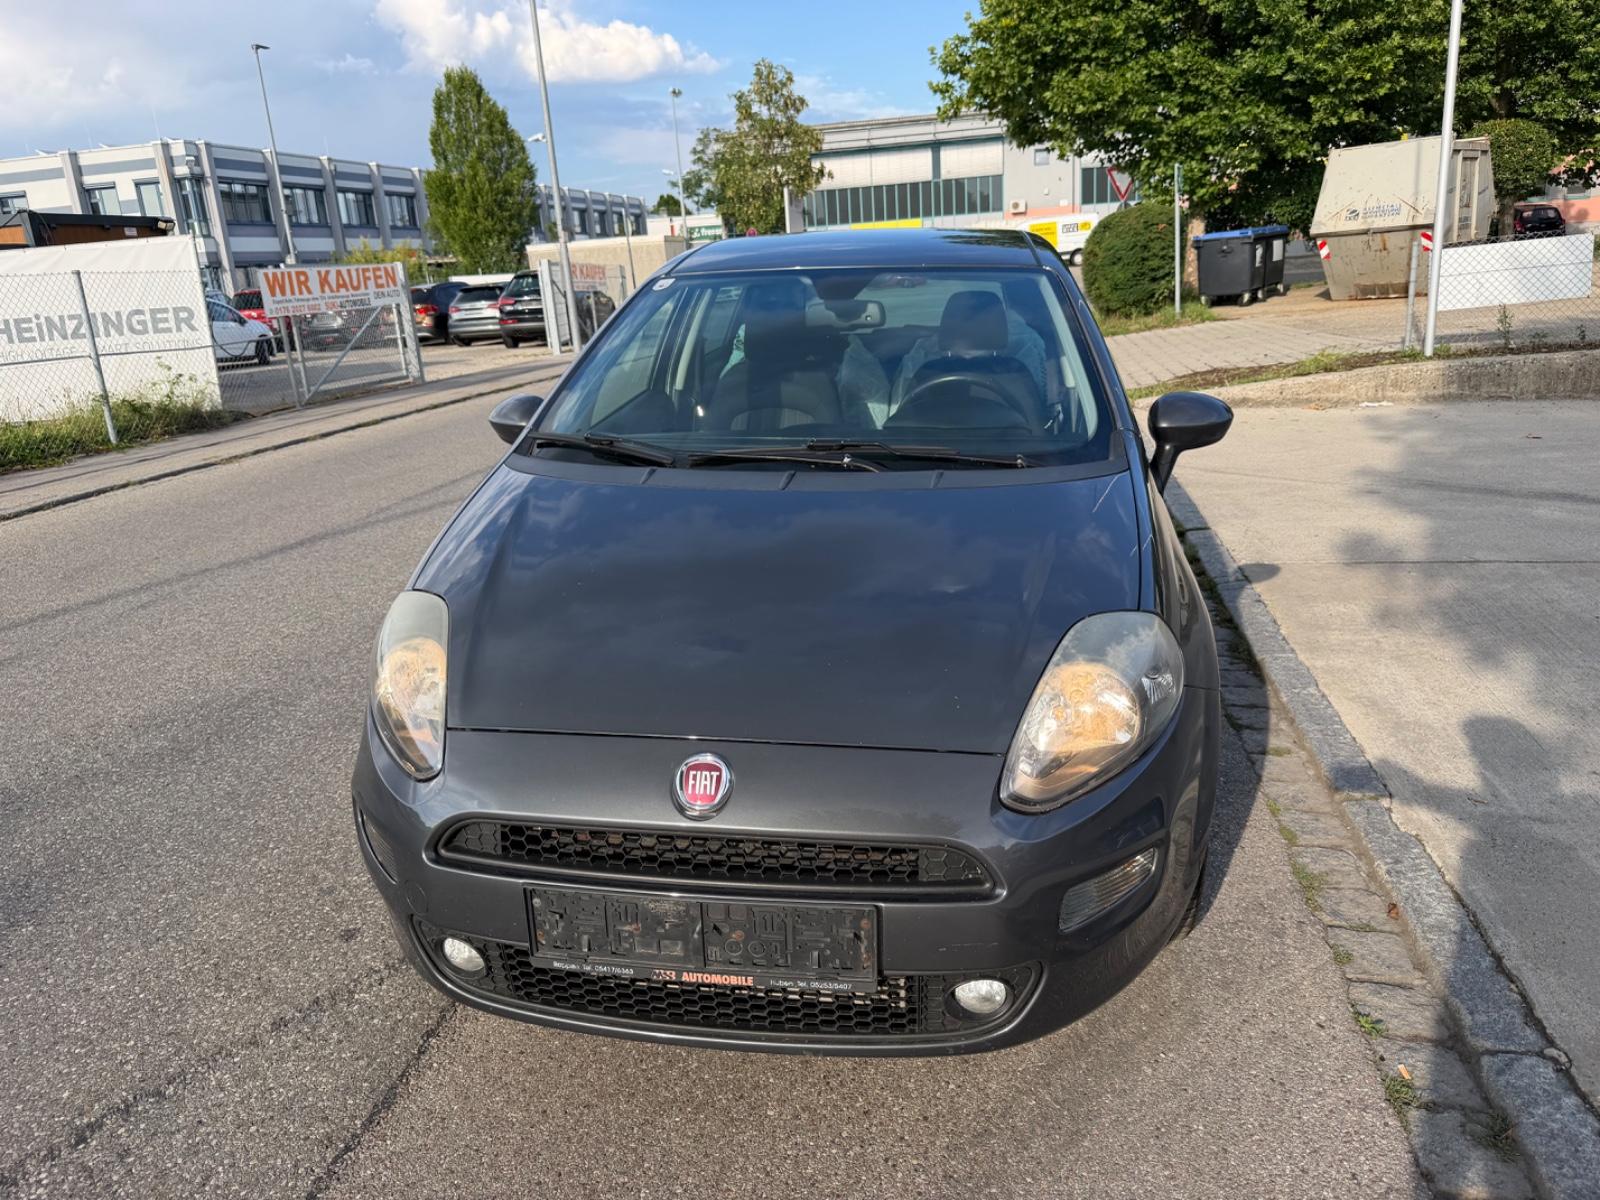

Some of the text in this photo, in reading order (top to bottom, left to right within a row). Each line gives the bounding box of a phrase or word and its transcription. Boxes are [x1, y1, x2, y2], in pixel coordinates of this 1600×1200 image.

[263, 270, 313, 298] WIR
[317, 265, 399, 294] KAUFEN
[687, 770, 720, 796] FIAT
[681, 971, 754, 987] AUTOMOBILE
